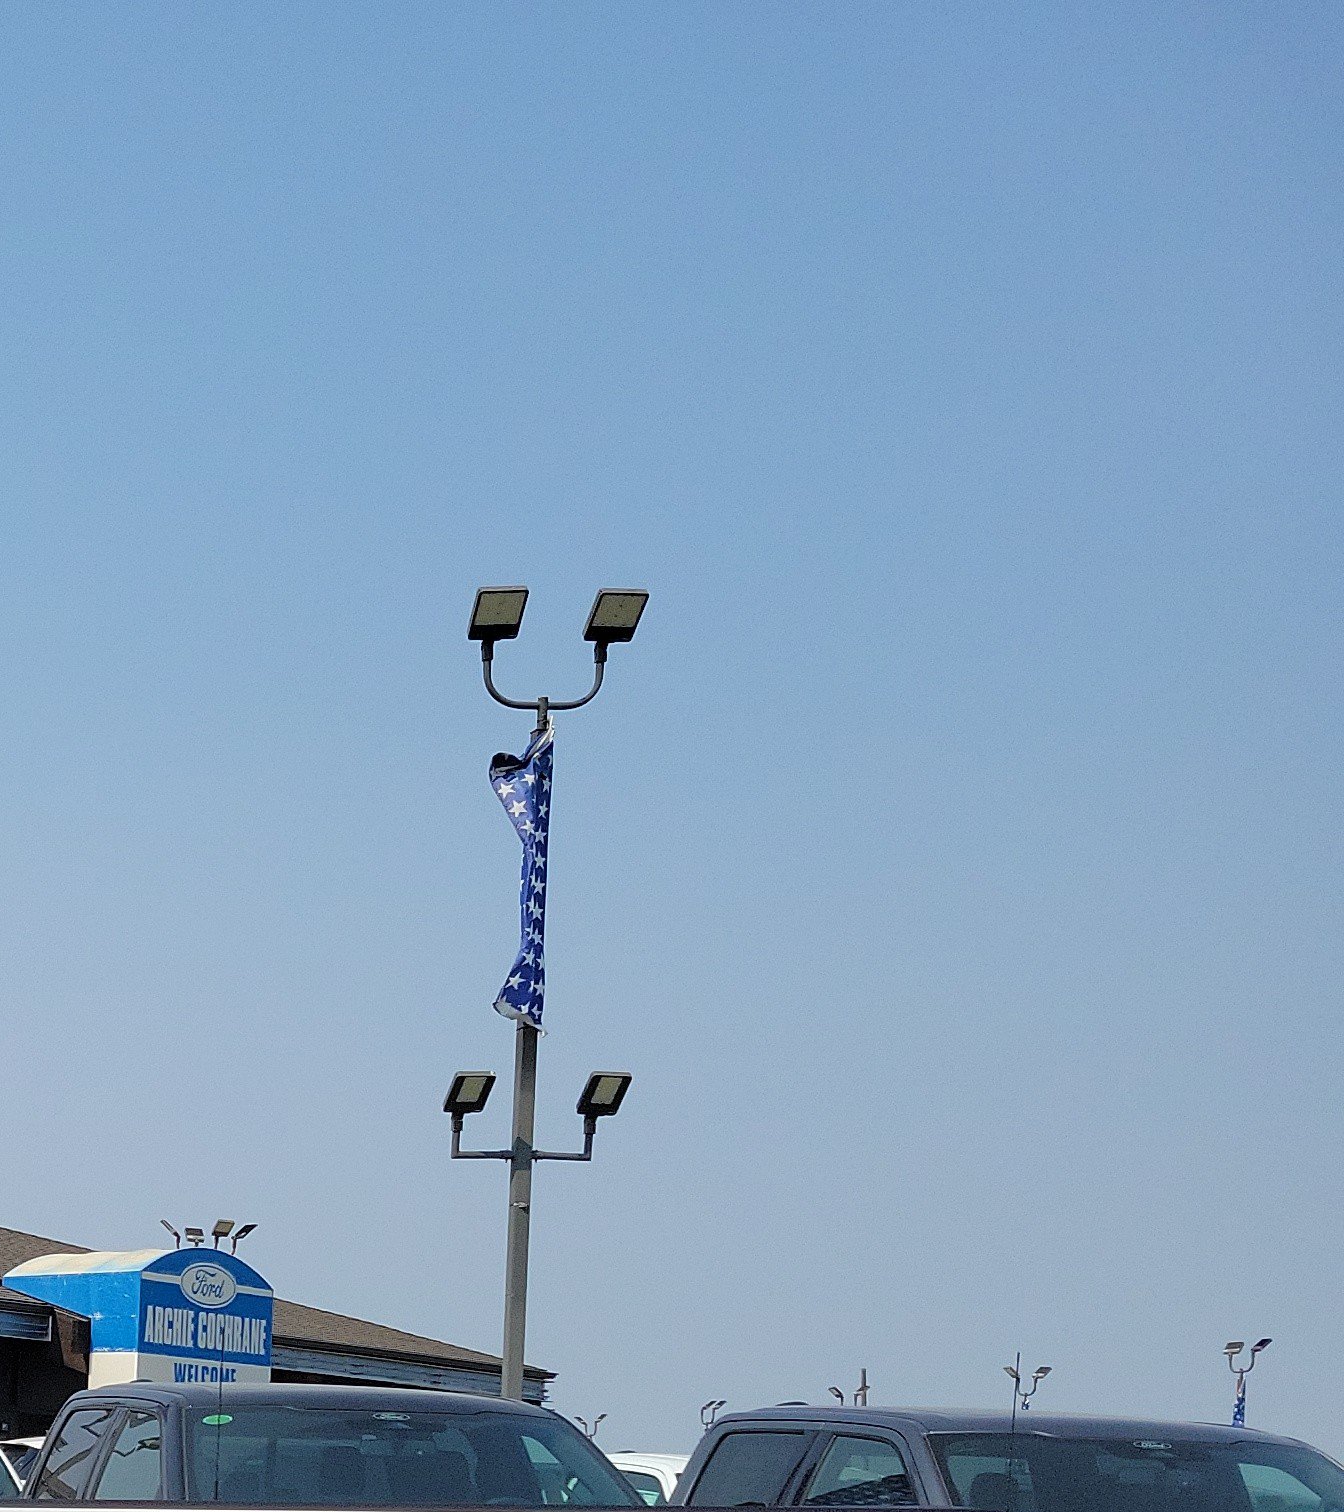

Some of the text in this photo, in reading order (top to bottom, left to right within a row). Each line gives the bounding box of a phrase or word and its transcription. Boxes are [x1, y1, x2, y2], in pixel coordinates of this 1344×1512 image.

[192, 1269, 225, 1299] Ford
[144, 1304, 267, 1356] ARCHIE COCHRANE
[173, 1362, 237, 1383] WELCOME
